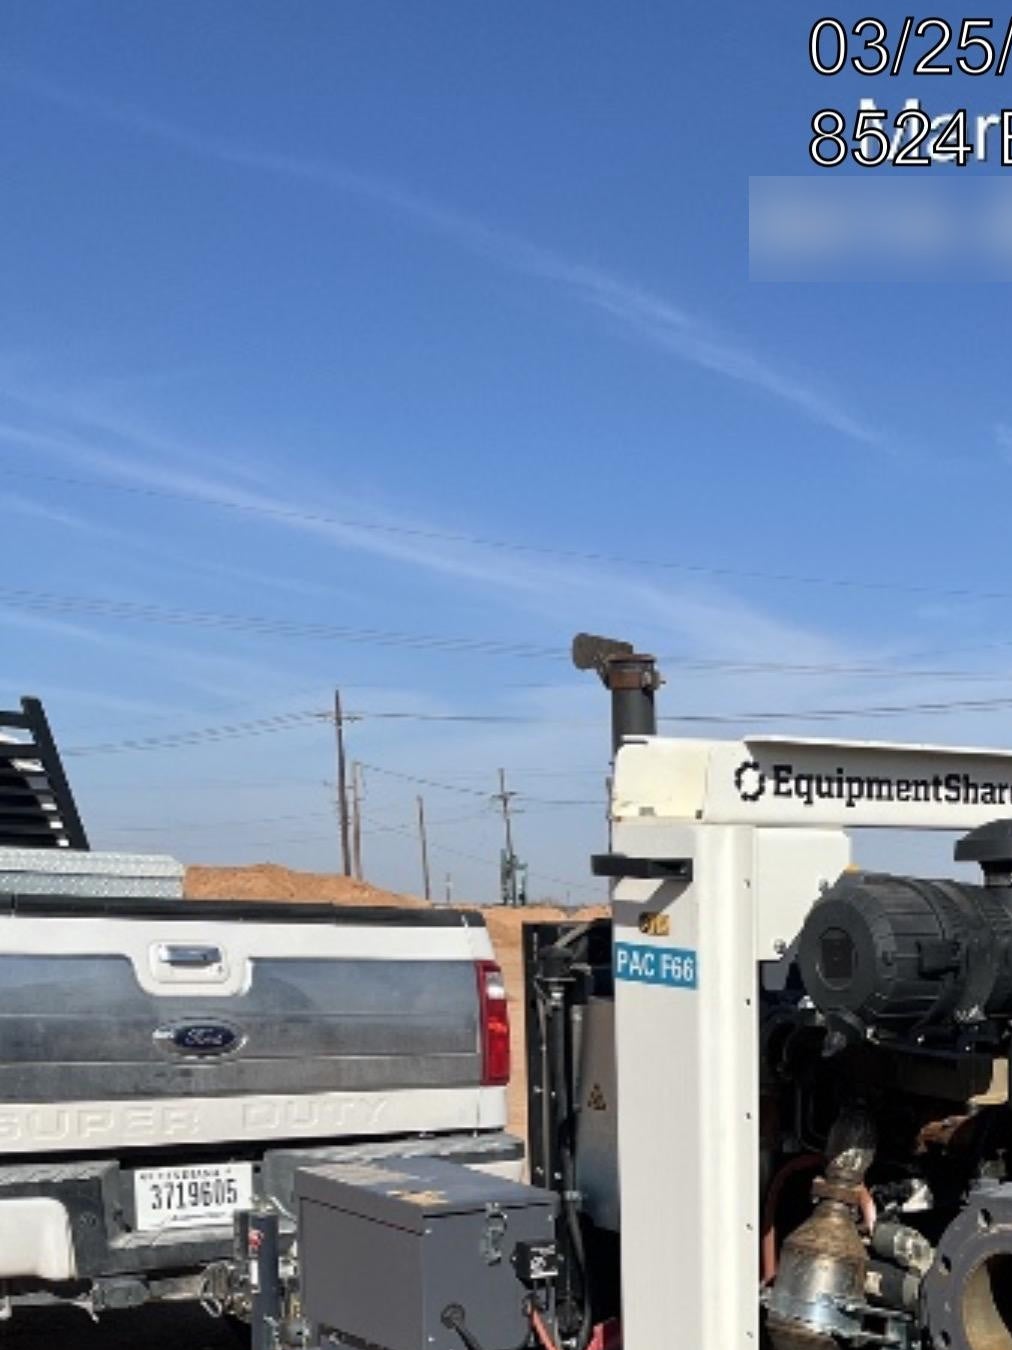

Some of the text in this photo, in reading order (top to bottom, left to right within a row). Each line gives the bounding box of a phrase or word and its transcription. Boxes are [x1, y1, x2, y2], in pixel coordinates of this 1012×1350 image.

[616, 949, 695, 982] PAC F66
[242, 1098, 390, 1132] DUTY
